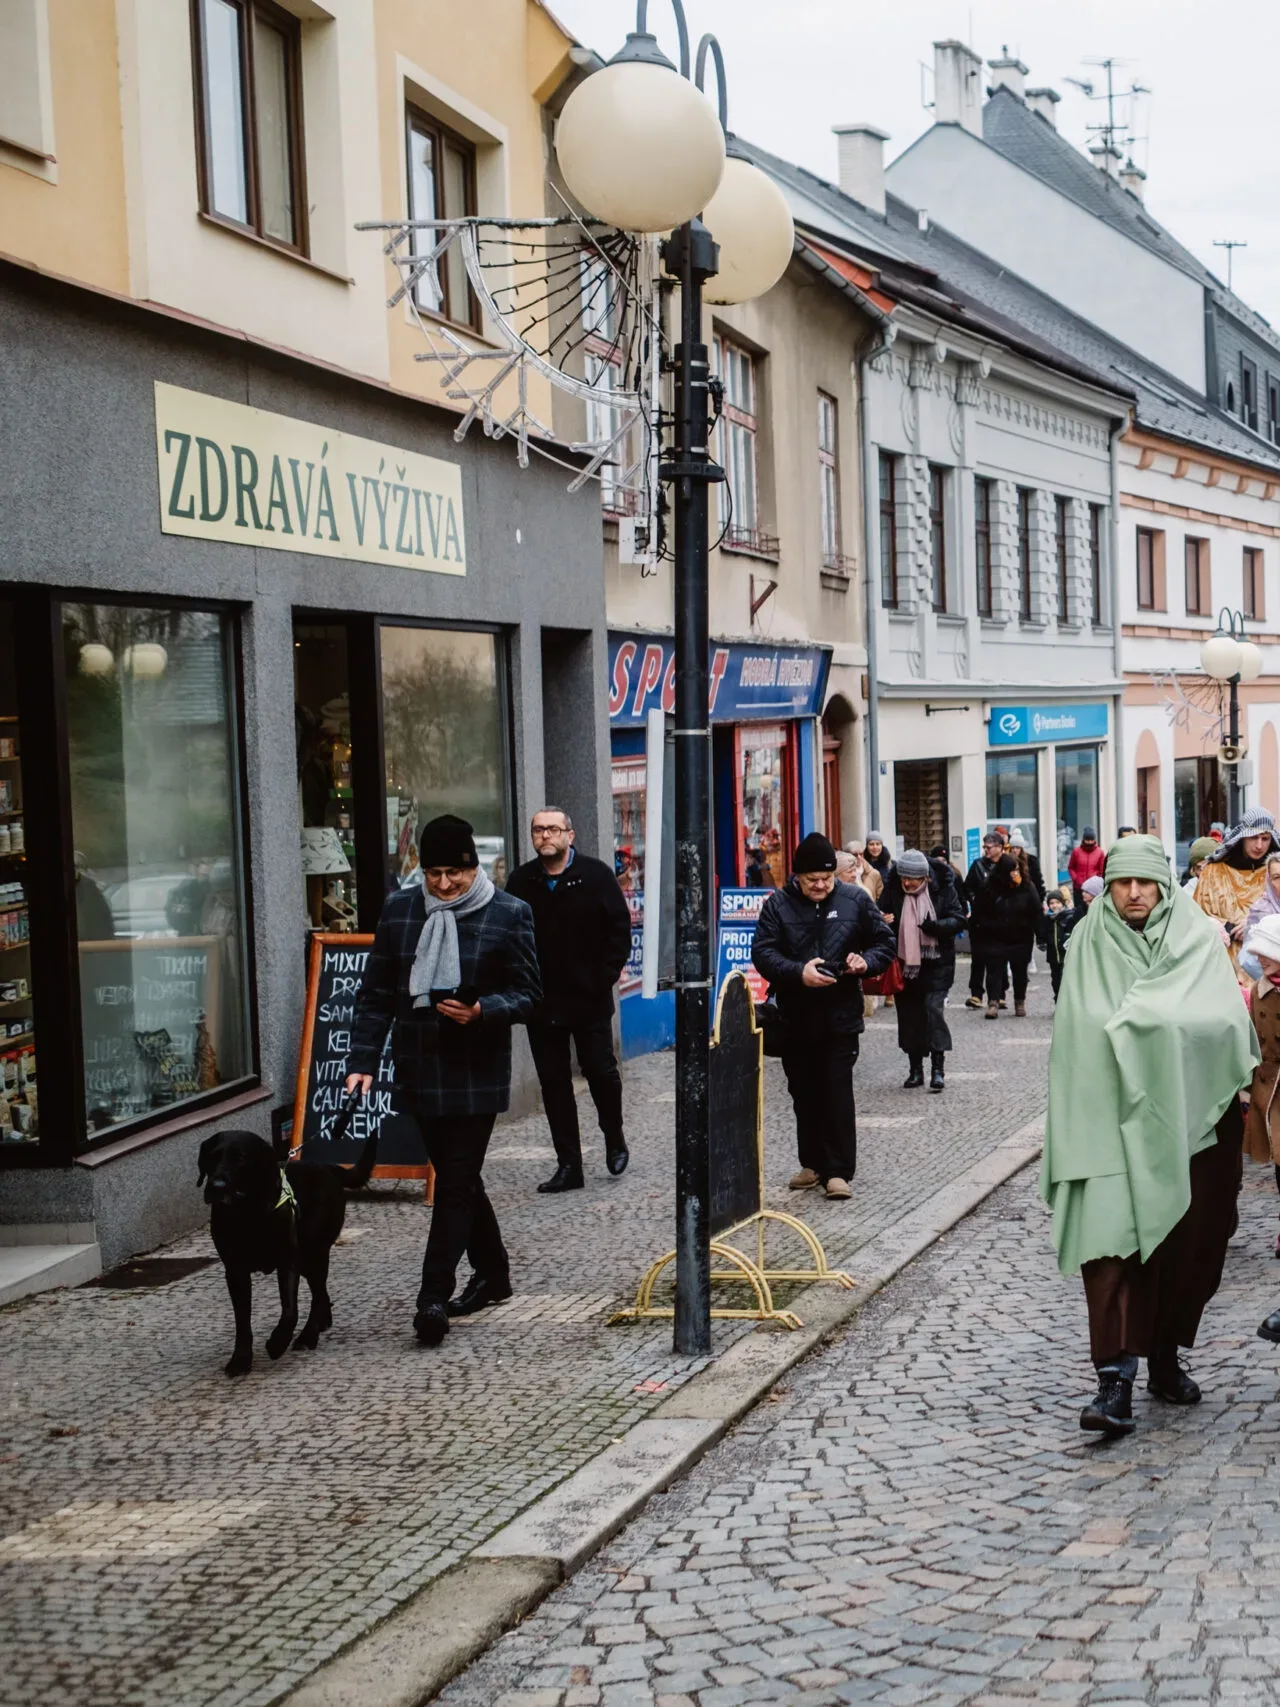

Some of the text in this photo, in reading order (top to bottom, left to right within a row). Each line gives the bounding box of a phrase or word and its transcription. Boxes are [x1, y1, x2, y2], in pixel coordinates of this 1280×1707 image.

[164, 428, 464, 563] ZDRAVÁ VÝŽIVA
[608, 640, 730, 717] SPT
[324, 952, 371, 972] MIXIT
[726, 947, 752, 961] OBU
